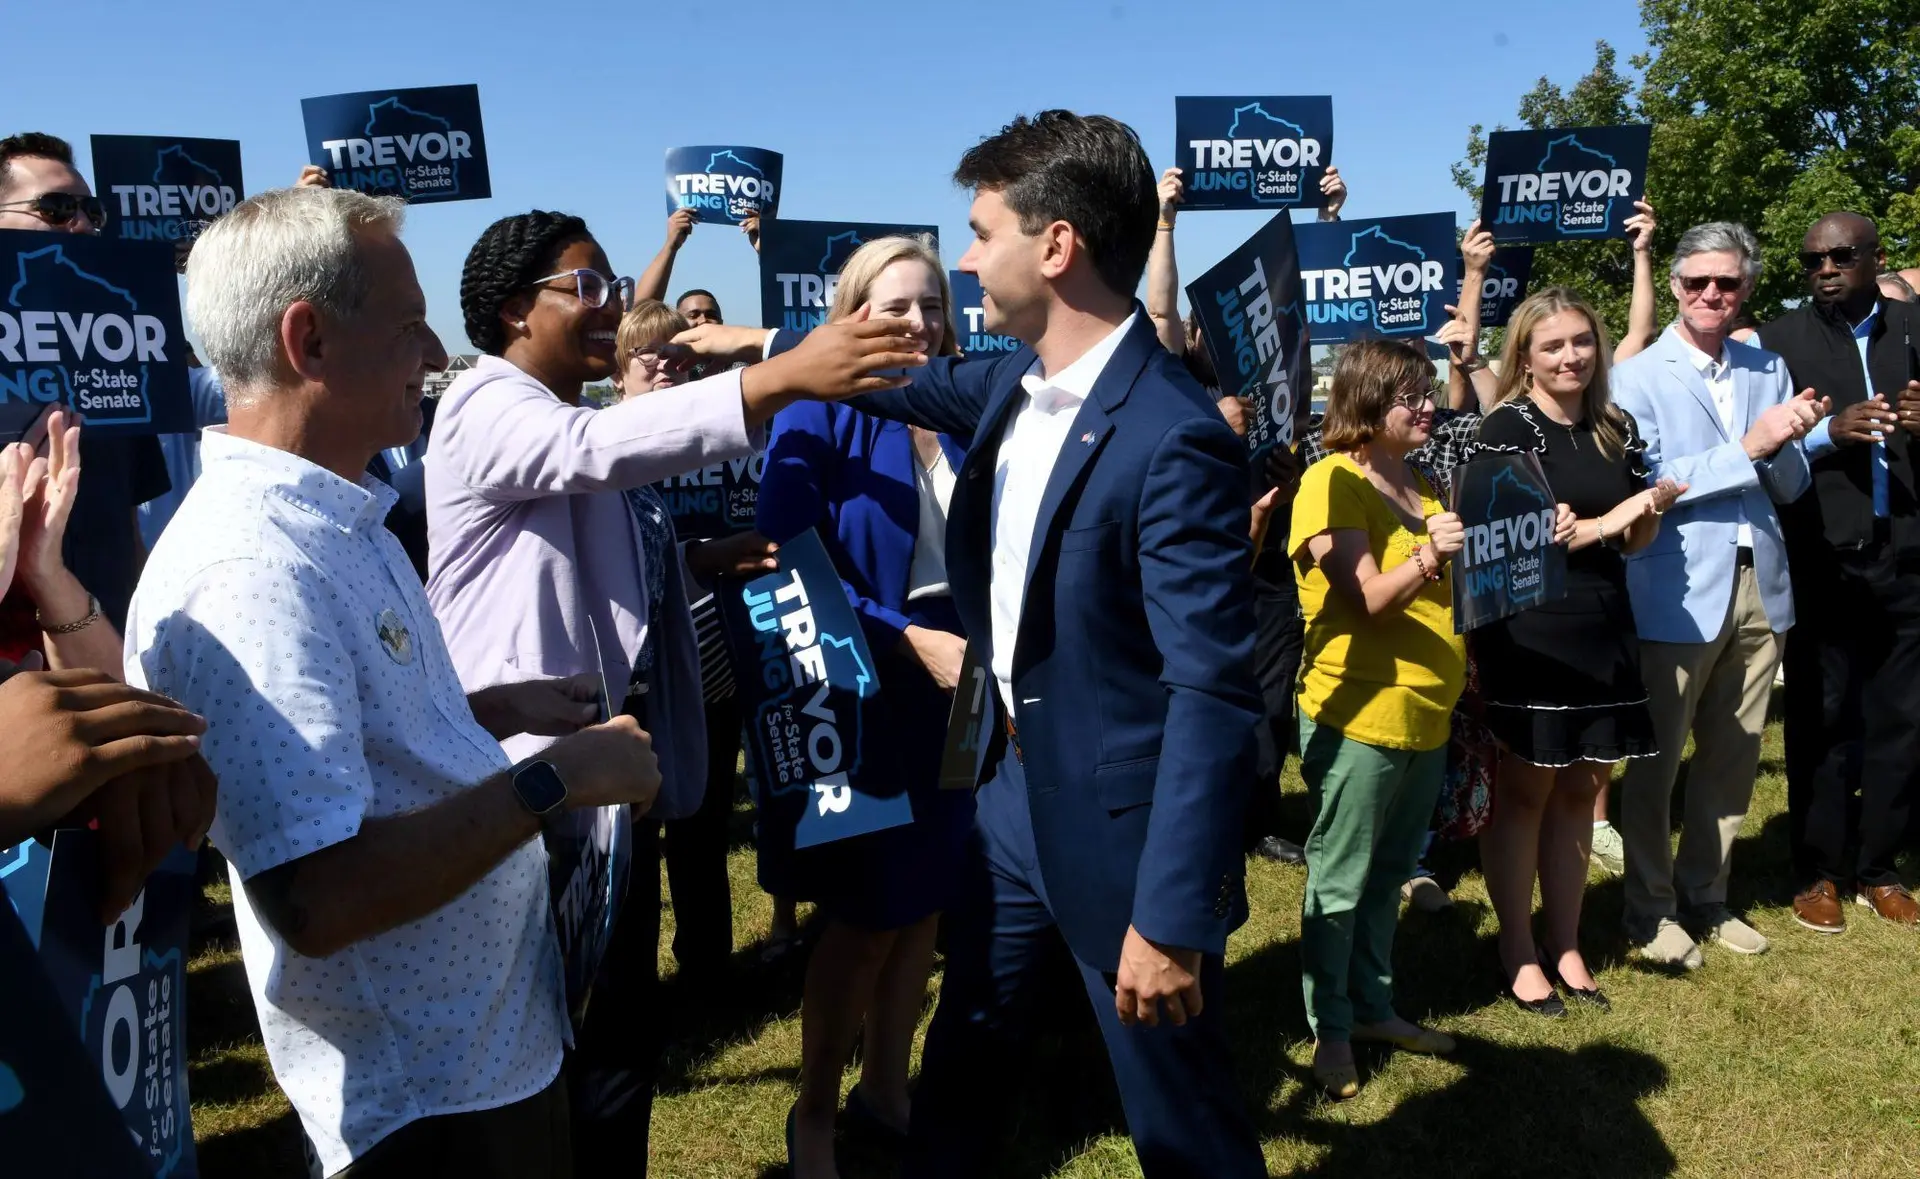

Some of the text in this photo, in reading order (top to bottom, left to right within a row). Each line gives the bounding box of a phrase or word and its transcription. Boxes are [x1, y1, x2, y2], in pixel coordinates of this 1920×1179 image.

[322, 131, 473, 169] TREVOR
[1190, 138, 1321, 168] TREVOR
[405, 167, 416, 177] for
[417, 164, 450, 178] State
[408, 177, 452, 189] Senate
[1189, 170, 1297, 191] JUNG for State
[1498, 169, 1632, 203] TREVOR
[111, 184, 236, 217] TREVOR
[675, 174, 774, 202] TREVOR
[676, 195, 722, 209] JUNG
[738, 197, 760, 209] State
[1258, 182, 1297, 194] Senate
[730, 205, 748, 216] Sen
[1493, 202, 1605, 225] JUNG for State
[1563, 213, 1604, 226] Senate
[119, 219, 181, 240] JUNG
[776, 273, 840, 307] TRE
[1300, 260, 1444, 301] TREVOR
[783, 311, 826, 332] JUN
[1305, 297, 1421, 324] JUNG for State
[1381, 311, 1421, 325] Senate
[0, 310, 168, 363] REVOR
[964, 334, 1017, 352] JUNG
[1216, 289, 1257, 376] JUNG
[1239, 256, 1295, 447] TREVOR
[0, 368, 138, 403] NG for State
[79, 389, 141, 410] Senate
[1256, 395, 1270, 441] State
[1462, 508, 1556, 568] TREVOR
[1517, 555, 1540, 573] State
[1512, 570, 1540, 591] Senate
[743, 588, 788, 691] JUNG
[775, 568, 852, 817] TREVOR
[766, 711, 791, 784] Senate
[780, 703, 806, 780] for State
[145, 979, 162, 1157] for State
[158, 974, 174, 1139] Senate
